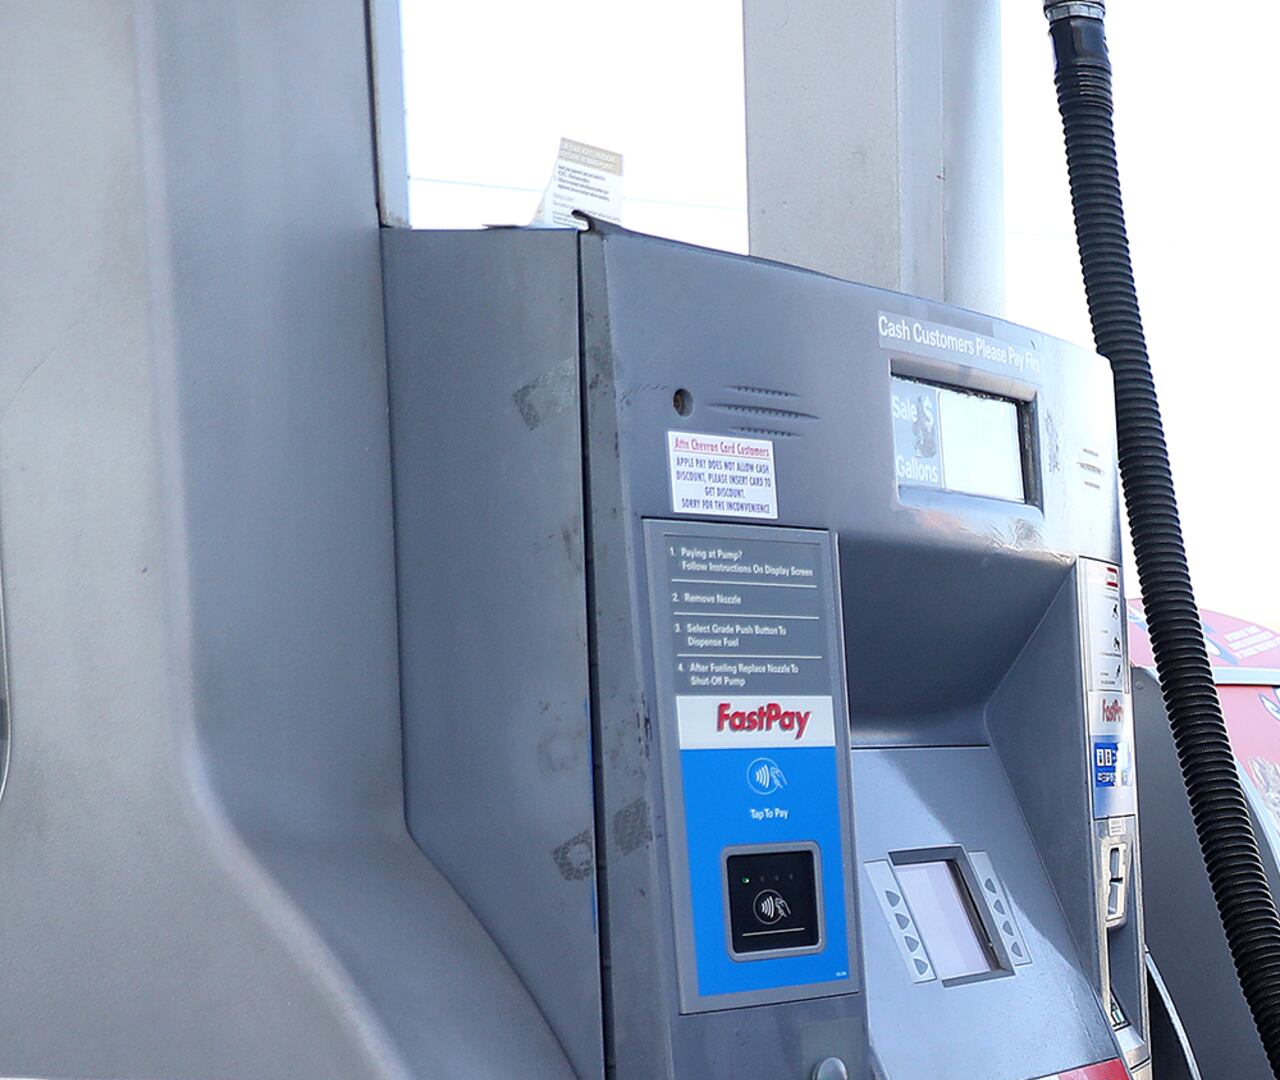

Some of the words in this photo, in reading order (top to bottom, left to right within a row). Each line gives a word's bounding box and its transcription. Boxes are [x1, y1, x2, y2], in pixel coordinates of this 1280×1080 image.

[879, 316, 910, 341] Cash
[913, 323, 975, 355] Customers
[976, 337, 1007, 364] Please
[1008, 347, 1025, 371] Pay
[892, 396, 917, 422] Sale
[923, 396, 934, 428] $
[691, 439, 718, 452] Chevron
[720, 442, 735, 453] Card
[737, 444, 770, 457] Customers
[677, 457, 694, 468] APPLE
[696, 458, 706, 469] PAY
[708, 460, 722, 470] DOES
[724, 461, 735, 471] NOT
[737, 463, 754, 473] ALLOW
[756, 464, 769, 475] CASH
[896, 454, 938, 484] Gallons
[676, 471, 706, 483] DISCOUNT,
[708, 473, 728, 484] PLEASE
[729, 475, 748, 486] INSERT
[750, 476, 763, 487] CARD
[765, 478, 771, 487] TO
[682, 498, 700, 508] SORRY
[702, 499, 713, 510] FOR
[715, 501, 725, 511] THE
[727, 502, 770, 514] INCONVENIENCE
[670, 547, 676, 556] 1.
[681, 547, 707, 560] Paying
[708, 549, 716, 558] at
[718, 550, 742, 562] Pump?
[682, 561, 707, 571] Follow
[709, 562, 751, 574] Instructions
[753, 565, 764, 574] On
[765, 566, 789, 577] Display
[791, 567, 813, 577] Screen
[672, 593, 680, 602] 2.
[684, 593, 714, 604] Remove
[716, 595, 741, 605] Nozzle
[675, 624, 681, 633] 3.
[686, 624, 710, 634] Select
[712, 624, 734, 634] Grade
[736, 625, 753, 635] Push
[755, 626, 778, 635] Button
[778, 626, 786, 636] To
[688, 636, 722, 648] Dispense
[723, 637, 739, 647] Fuel
[678, 663, 684, 672] 4.
[690, 663, 708, 673] After
[710, 663, 737, 675] Fueling
[738, 664, 766, 675] Replace
[767, 664, 790, 674] Nozzle
[790, 664, 799, 674] To
[691, 676, 723, 686] Shut-Off
[724, 677, 745, 688] Pump
[716, 703, 811, 739] FastPay
[751, 808, 763, 820] Tap
[765, 809, 773, 818] To
[774, 808, 788, 820] Pay
